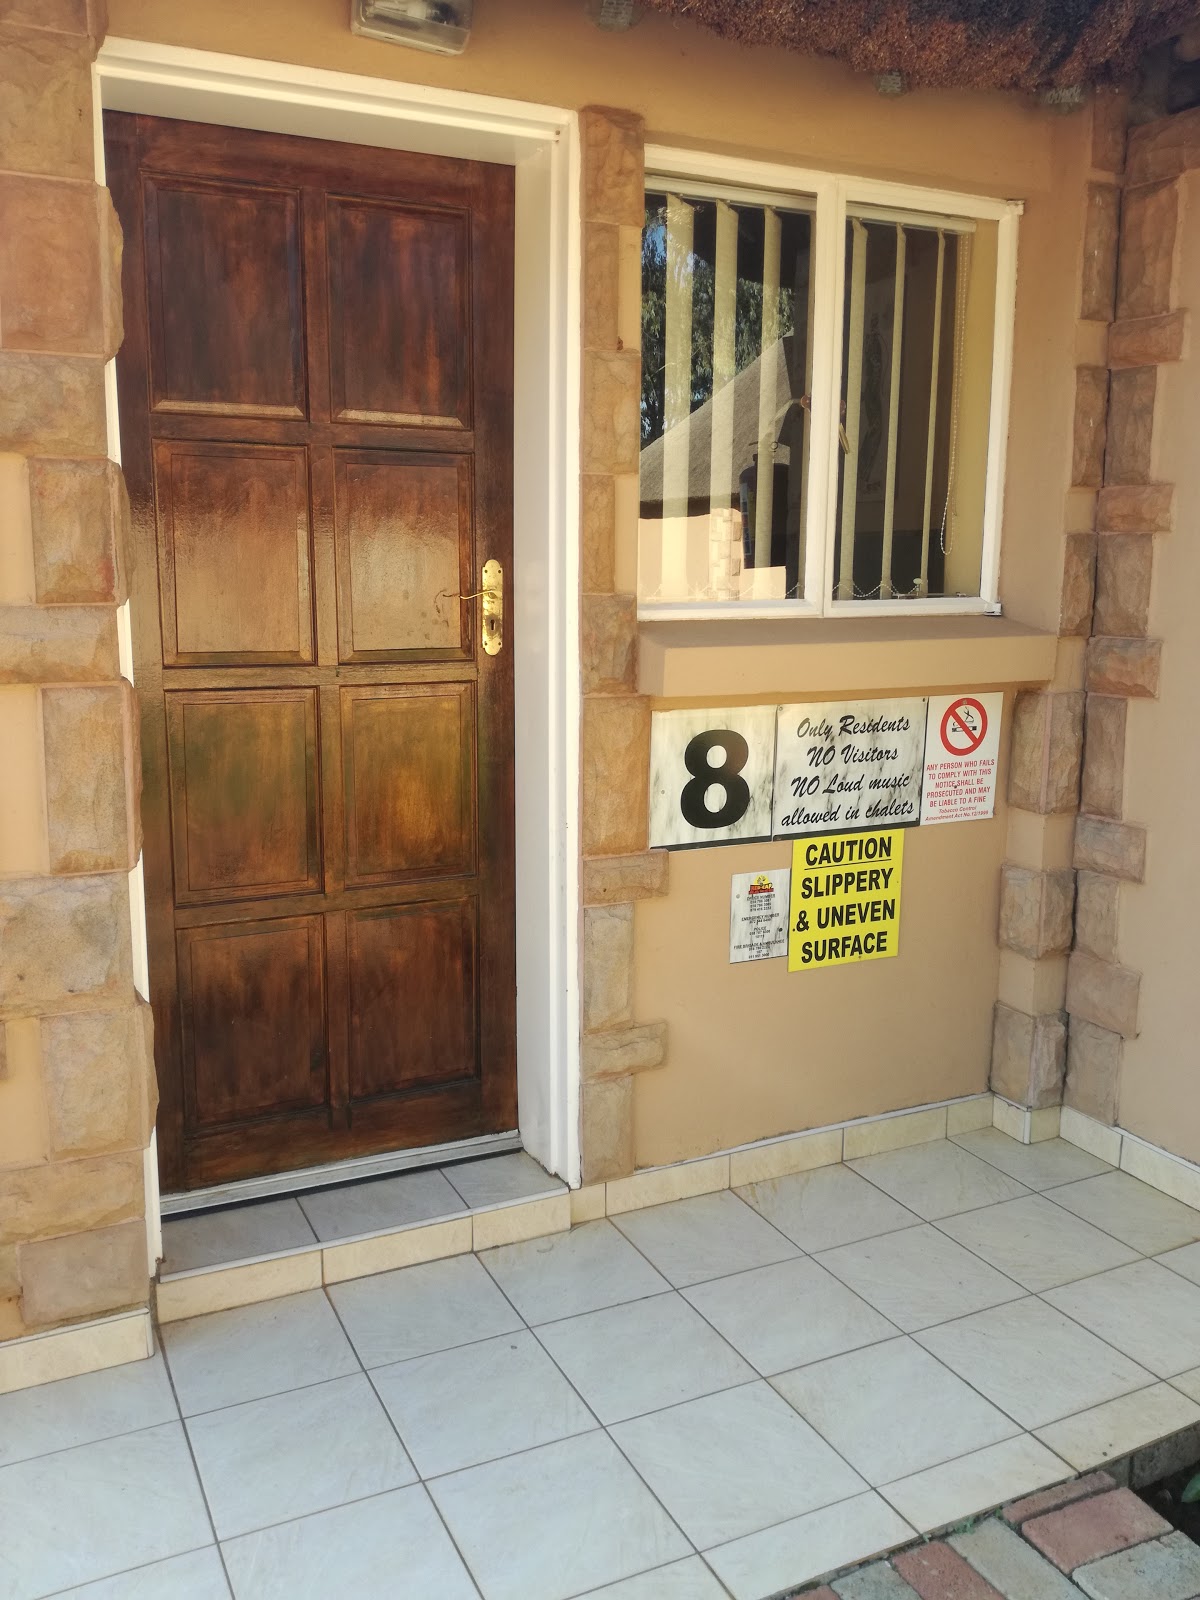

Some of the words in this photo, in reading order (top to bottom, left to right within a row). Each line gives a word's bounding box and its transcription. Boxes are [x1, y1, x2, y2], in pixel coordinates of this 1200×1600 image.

[797, 718, 832, 742] Only
[838, 714, 910, 736] Residents
[807, 745, 836, 768] NO
[840, 744, 898, 764] Visitors
[680, 729, 750, 829] 8
[790, 776, 820, 798] NO
[822, 773, 864, 794] Loud
[868, 773, 910, 790] music
[927, 789, 963, 798] PROSECUTED
[781, 804, 841, 826] allowed
[846, 806, 860, 820] in
[865, 798, 914, 818] chalets
[806, 836, 892, 866] CAUTION
[801, 868, 894, 899] SLIPPERY
[796, 910, 810, 932] &
[818, 899, 895, 929] UNEVEN
[802, 931, 888, 964] SURFACE
